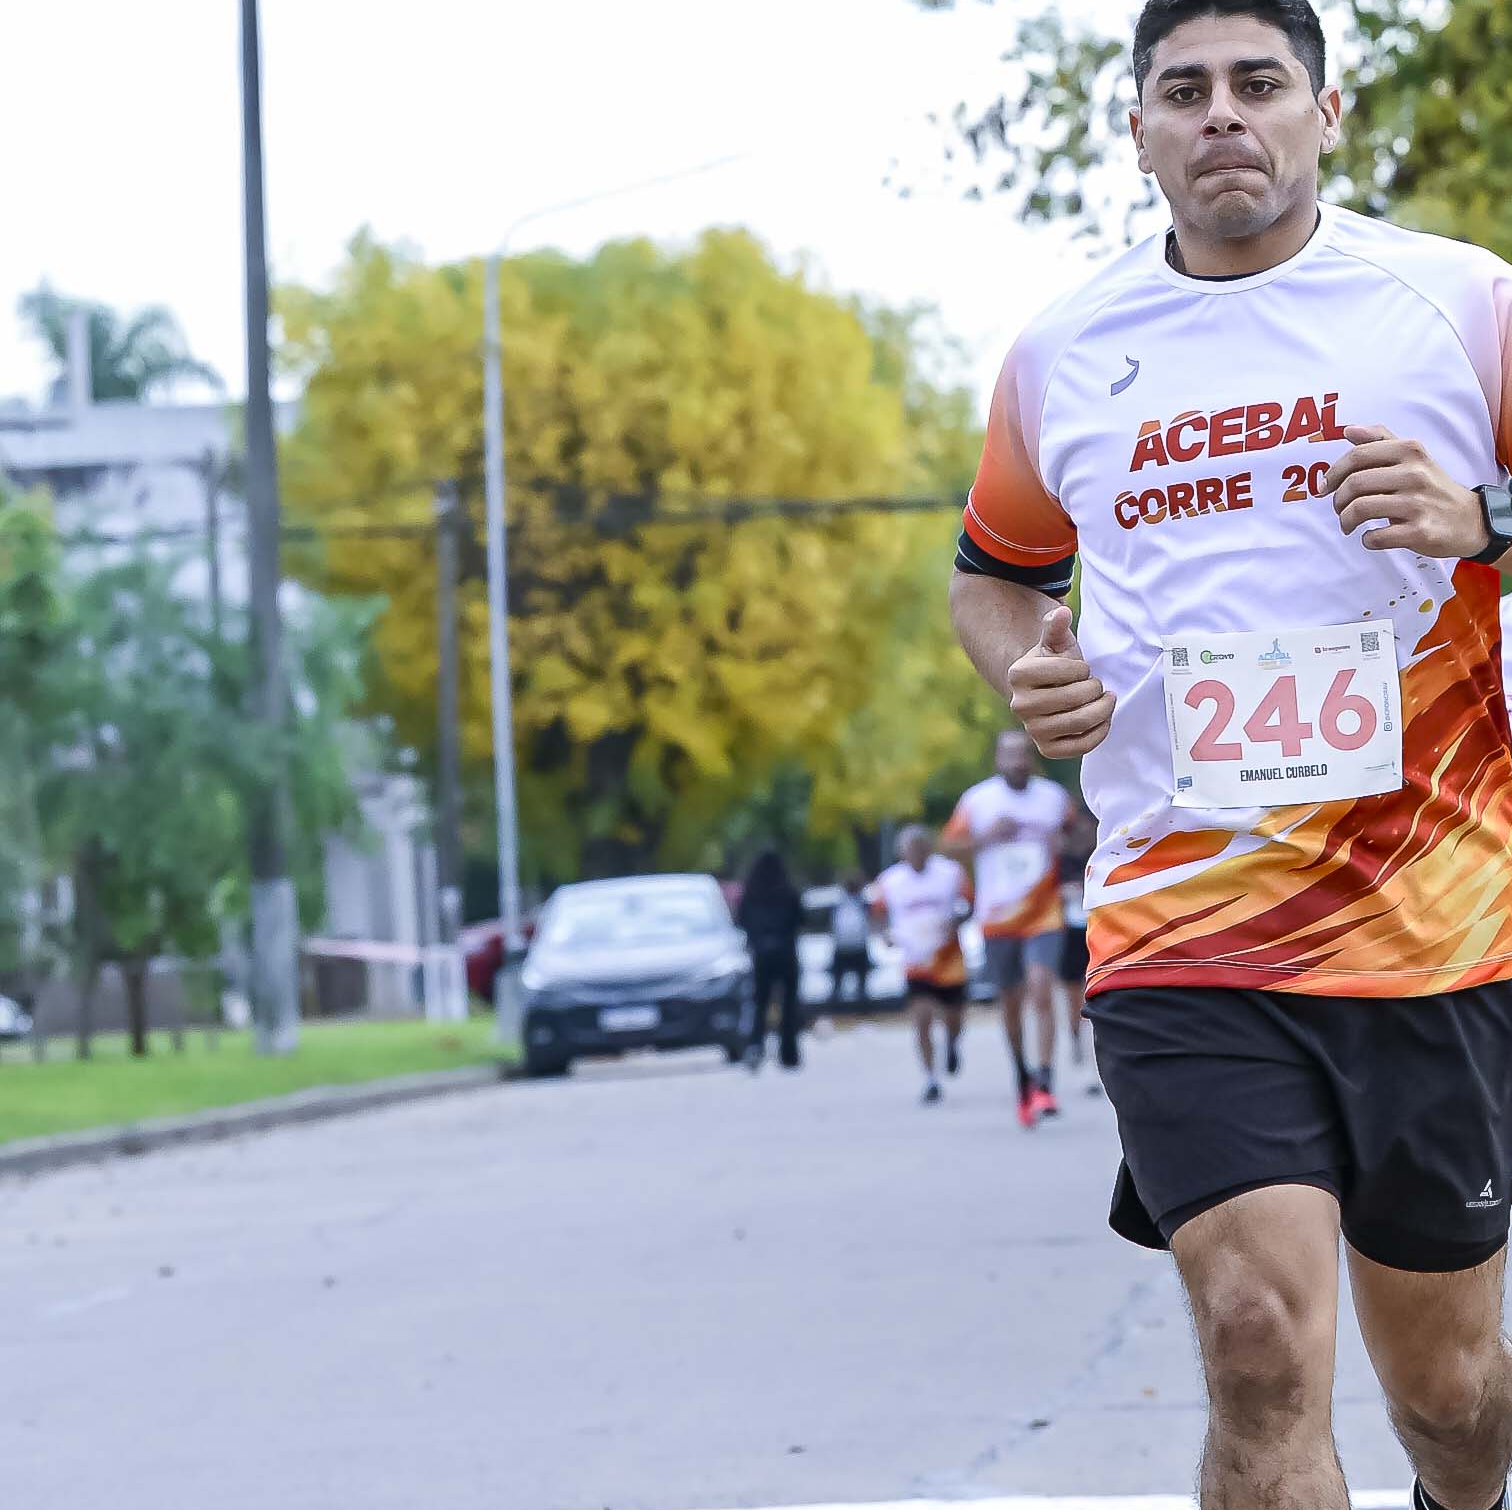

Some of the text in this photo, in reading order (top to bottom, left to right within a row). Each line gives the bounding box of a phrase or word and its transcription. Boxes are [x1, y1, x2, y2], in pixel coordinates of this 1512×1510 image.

[1129, 392, 1346, 472] ACEBAL
[1114, 461, 1332, 529] CORRE 20
[1184, 668, 1377, 762] 246
[1240, 763, 1328, 782] EMANUEL CURBELO
